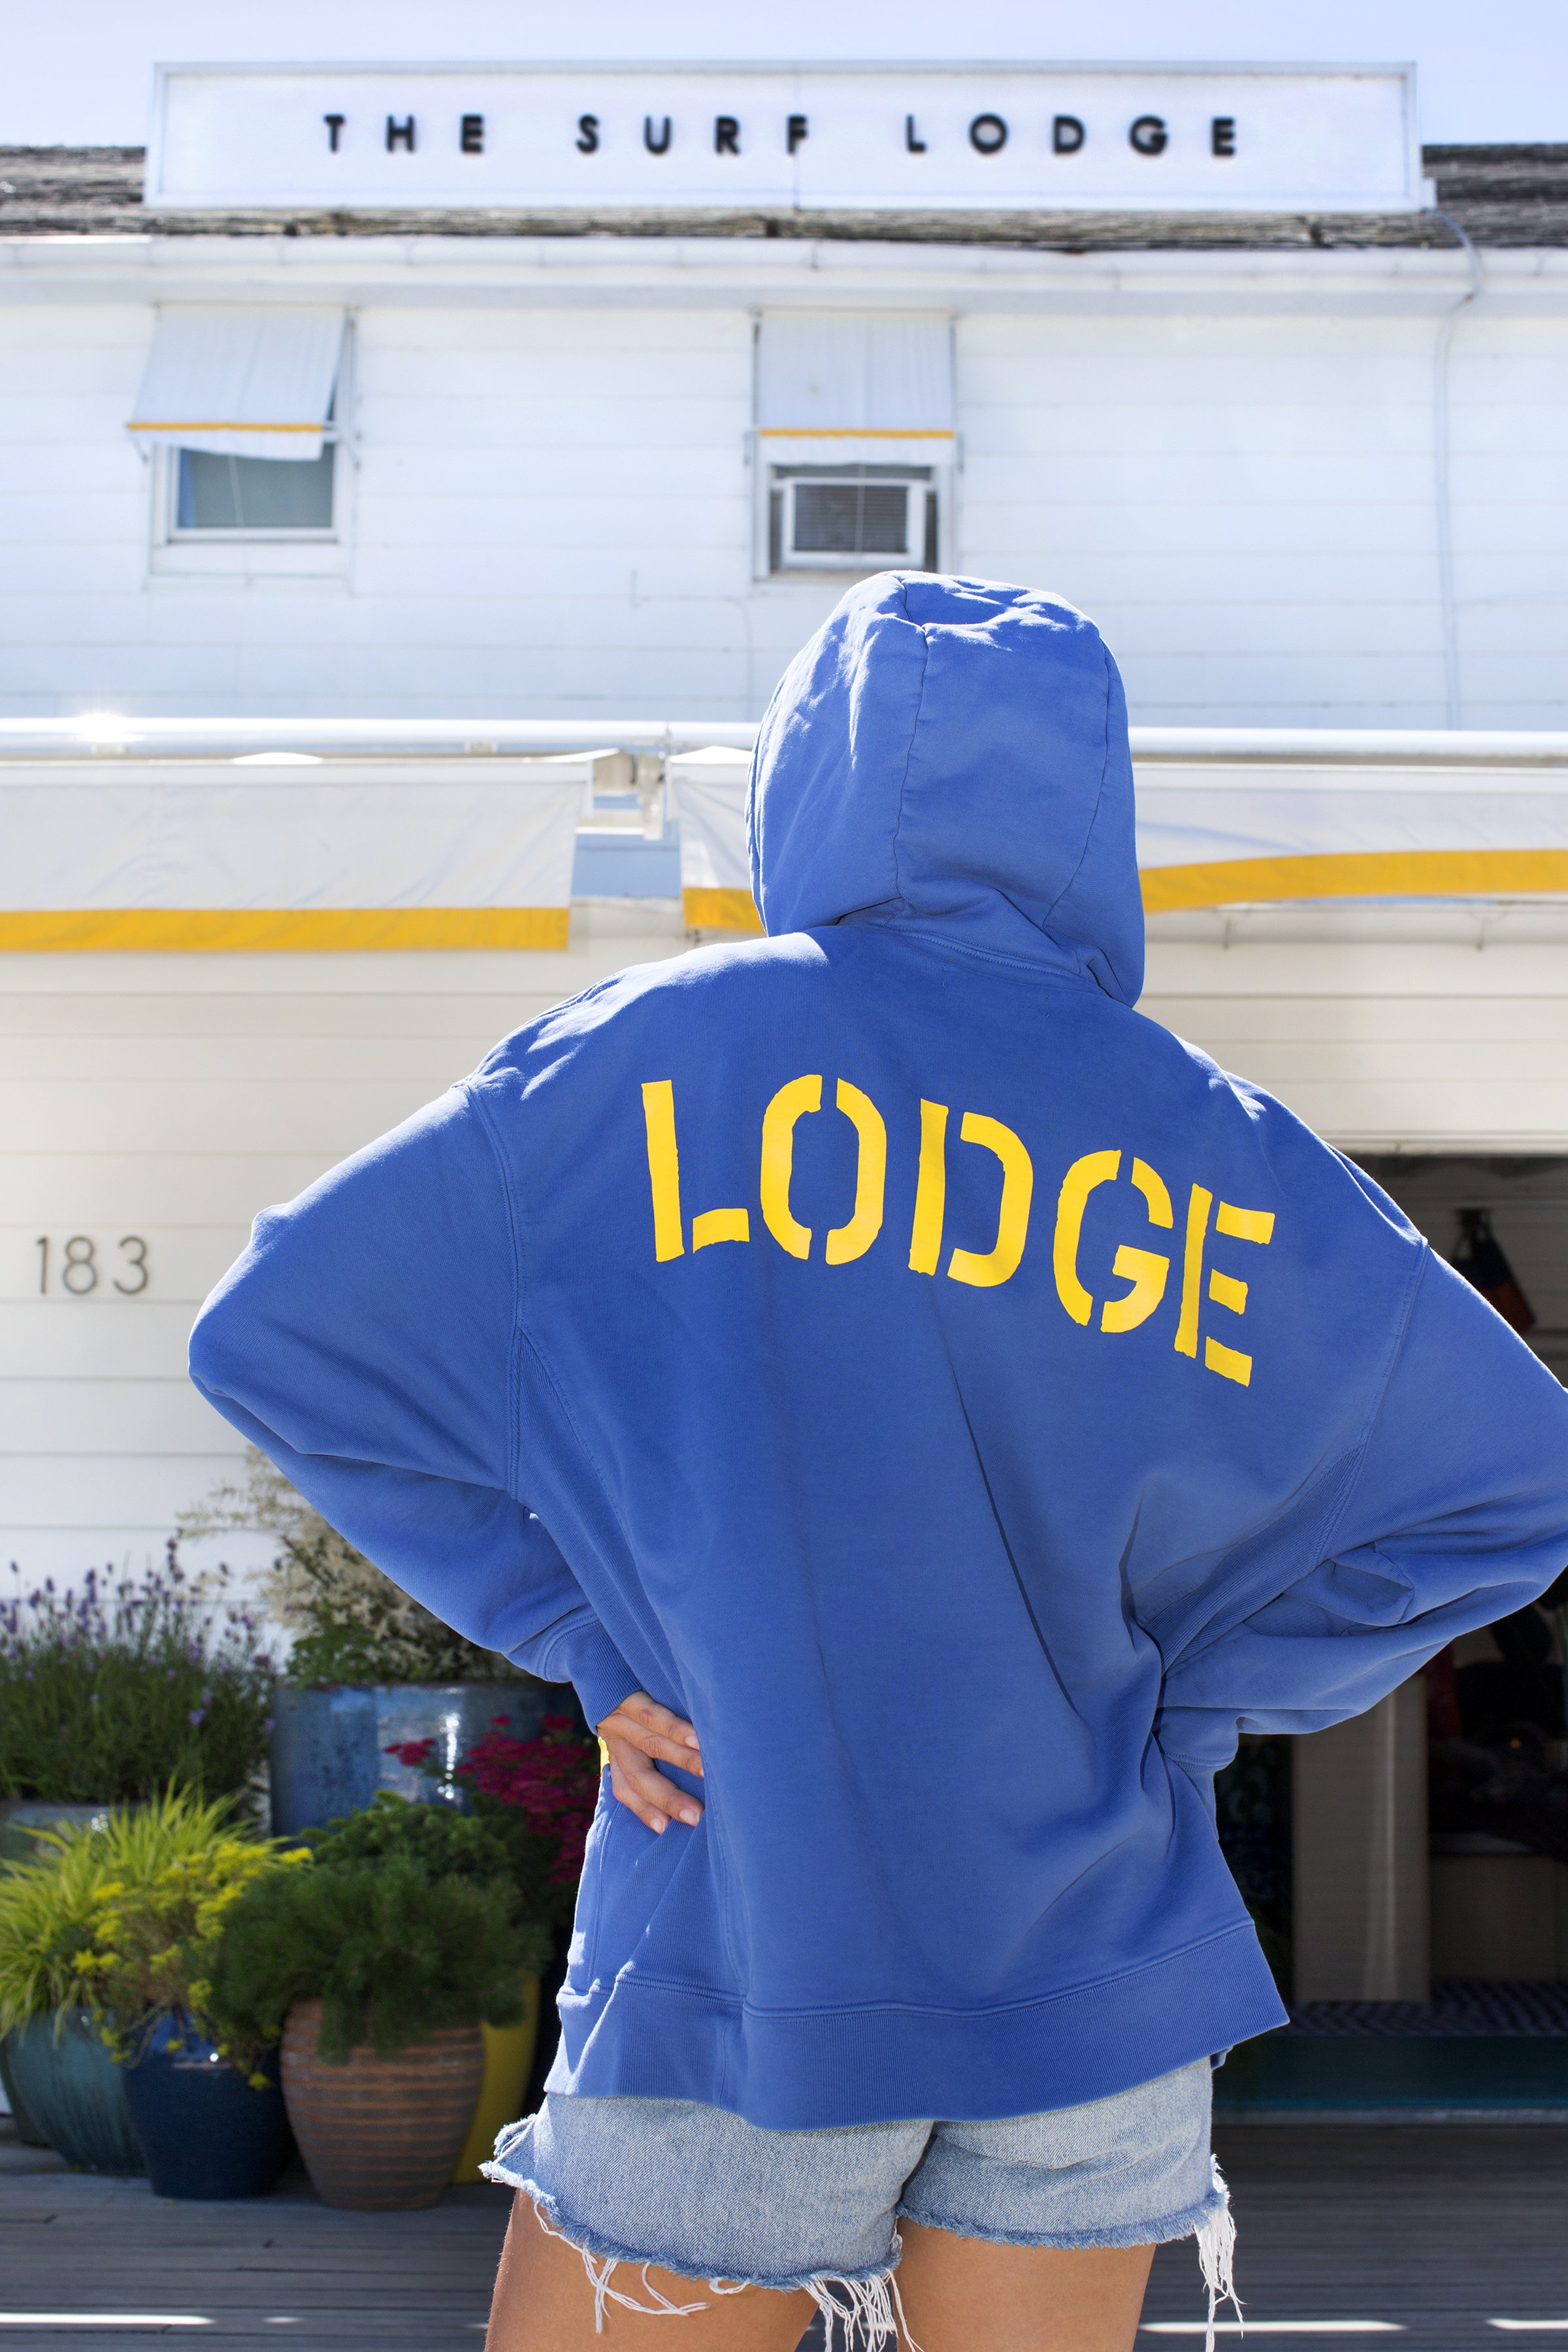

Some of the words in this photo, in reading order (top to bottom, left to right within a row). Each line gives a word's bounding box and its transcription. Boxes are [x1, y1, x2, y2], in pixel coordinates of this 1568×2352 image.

[323, 113, 485, 155] THE
[574, 113, 809, 155] SURF
[905, 112, 1237, 157] LODGE
[641, 1074, 1275, 1387] LODGE
[35, 1235, 149, 1295] 183
